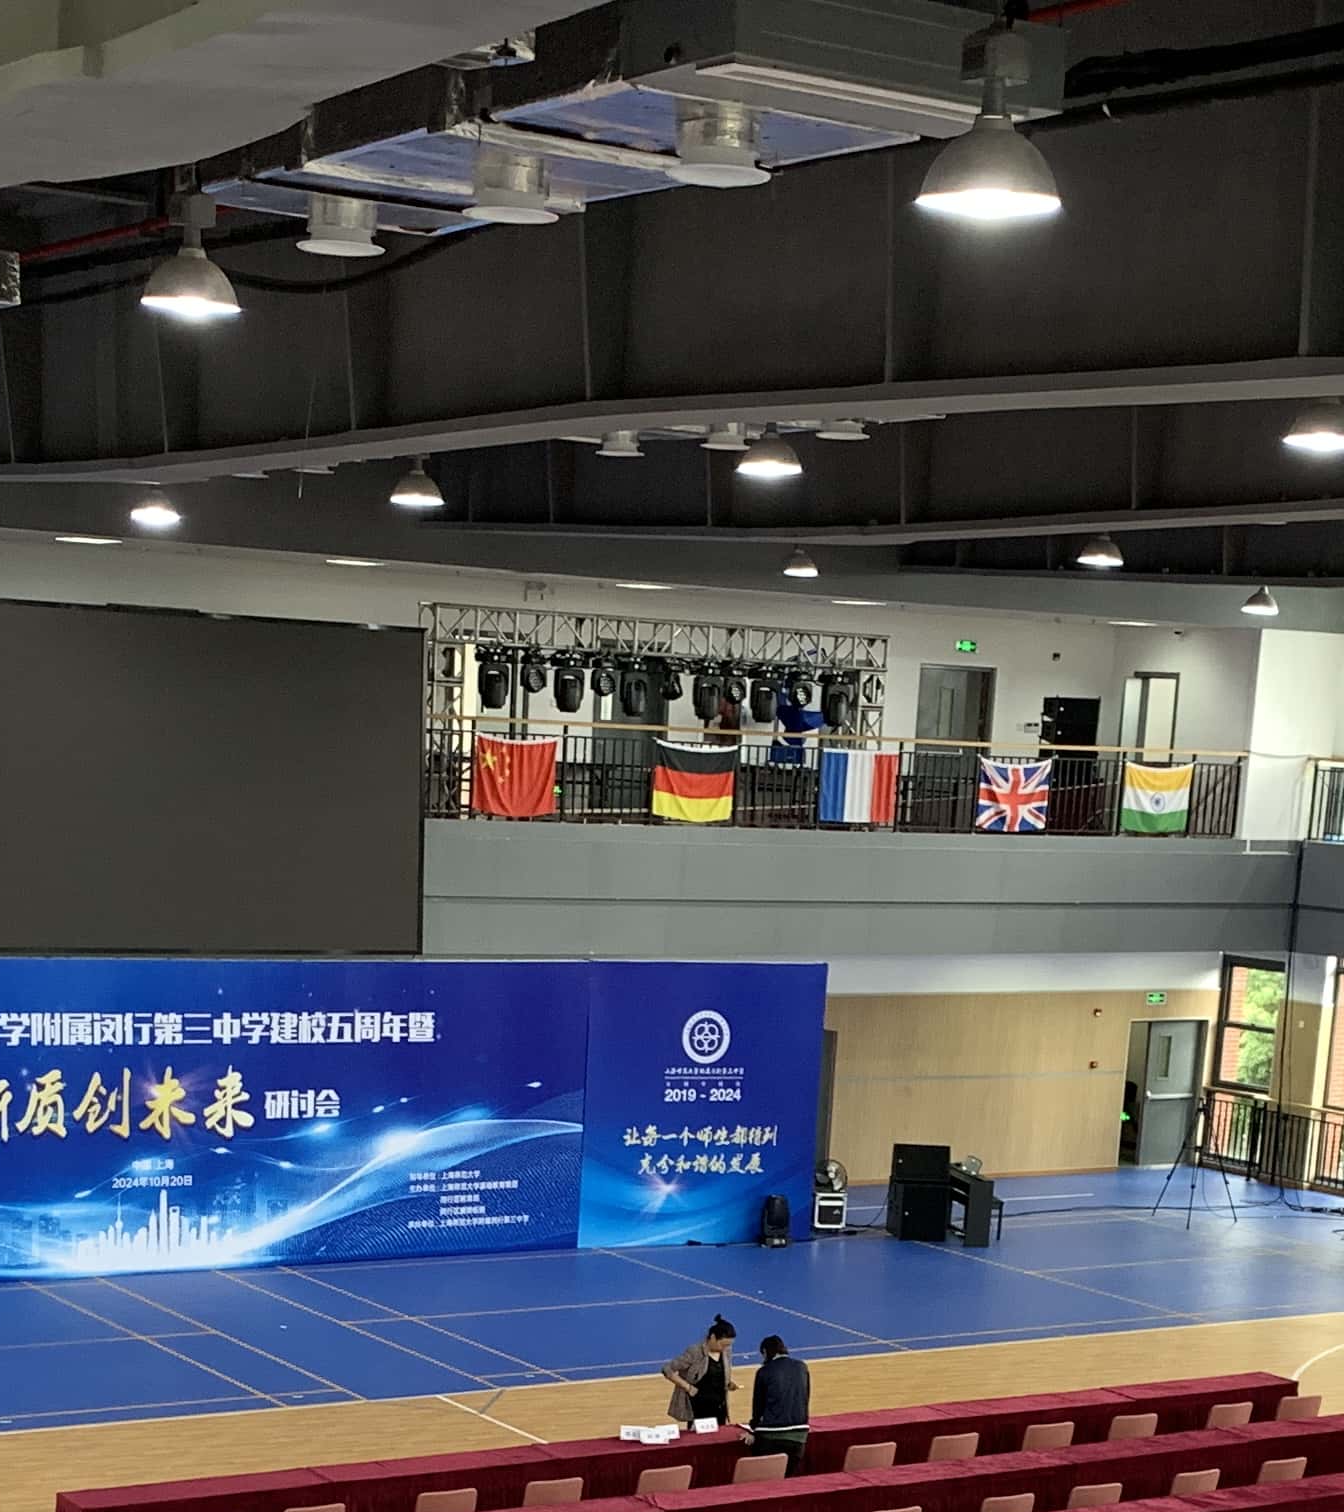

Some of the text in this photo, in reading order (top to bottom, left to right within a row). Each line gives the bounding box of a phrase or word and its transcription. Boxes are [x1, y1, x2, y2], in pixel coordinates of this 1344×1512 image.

[664, 1088, 697, 1102] 2019
[709, 1088, 742, 1102] 2024
[264, 1089, 341, 1119] 研讨会
[111, 1174, 193, 1190] 2024年10月20日
